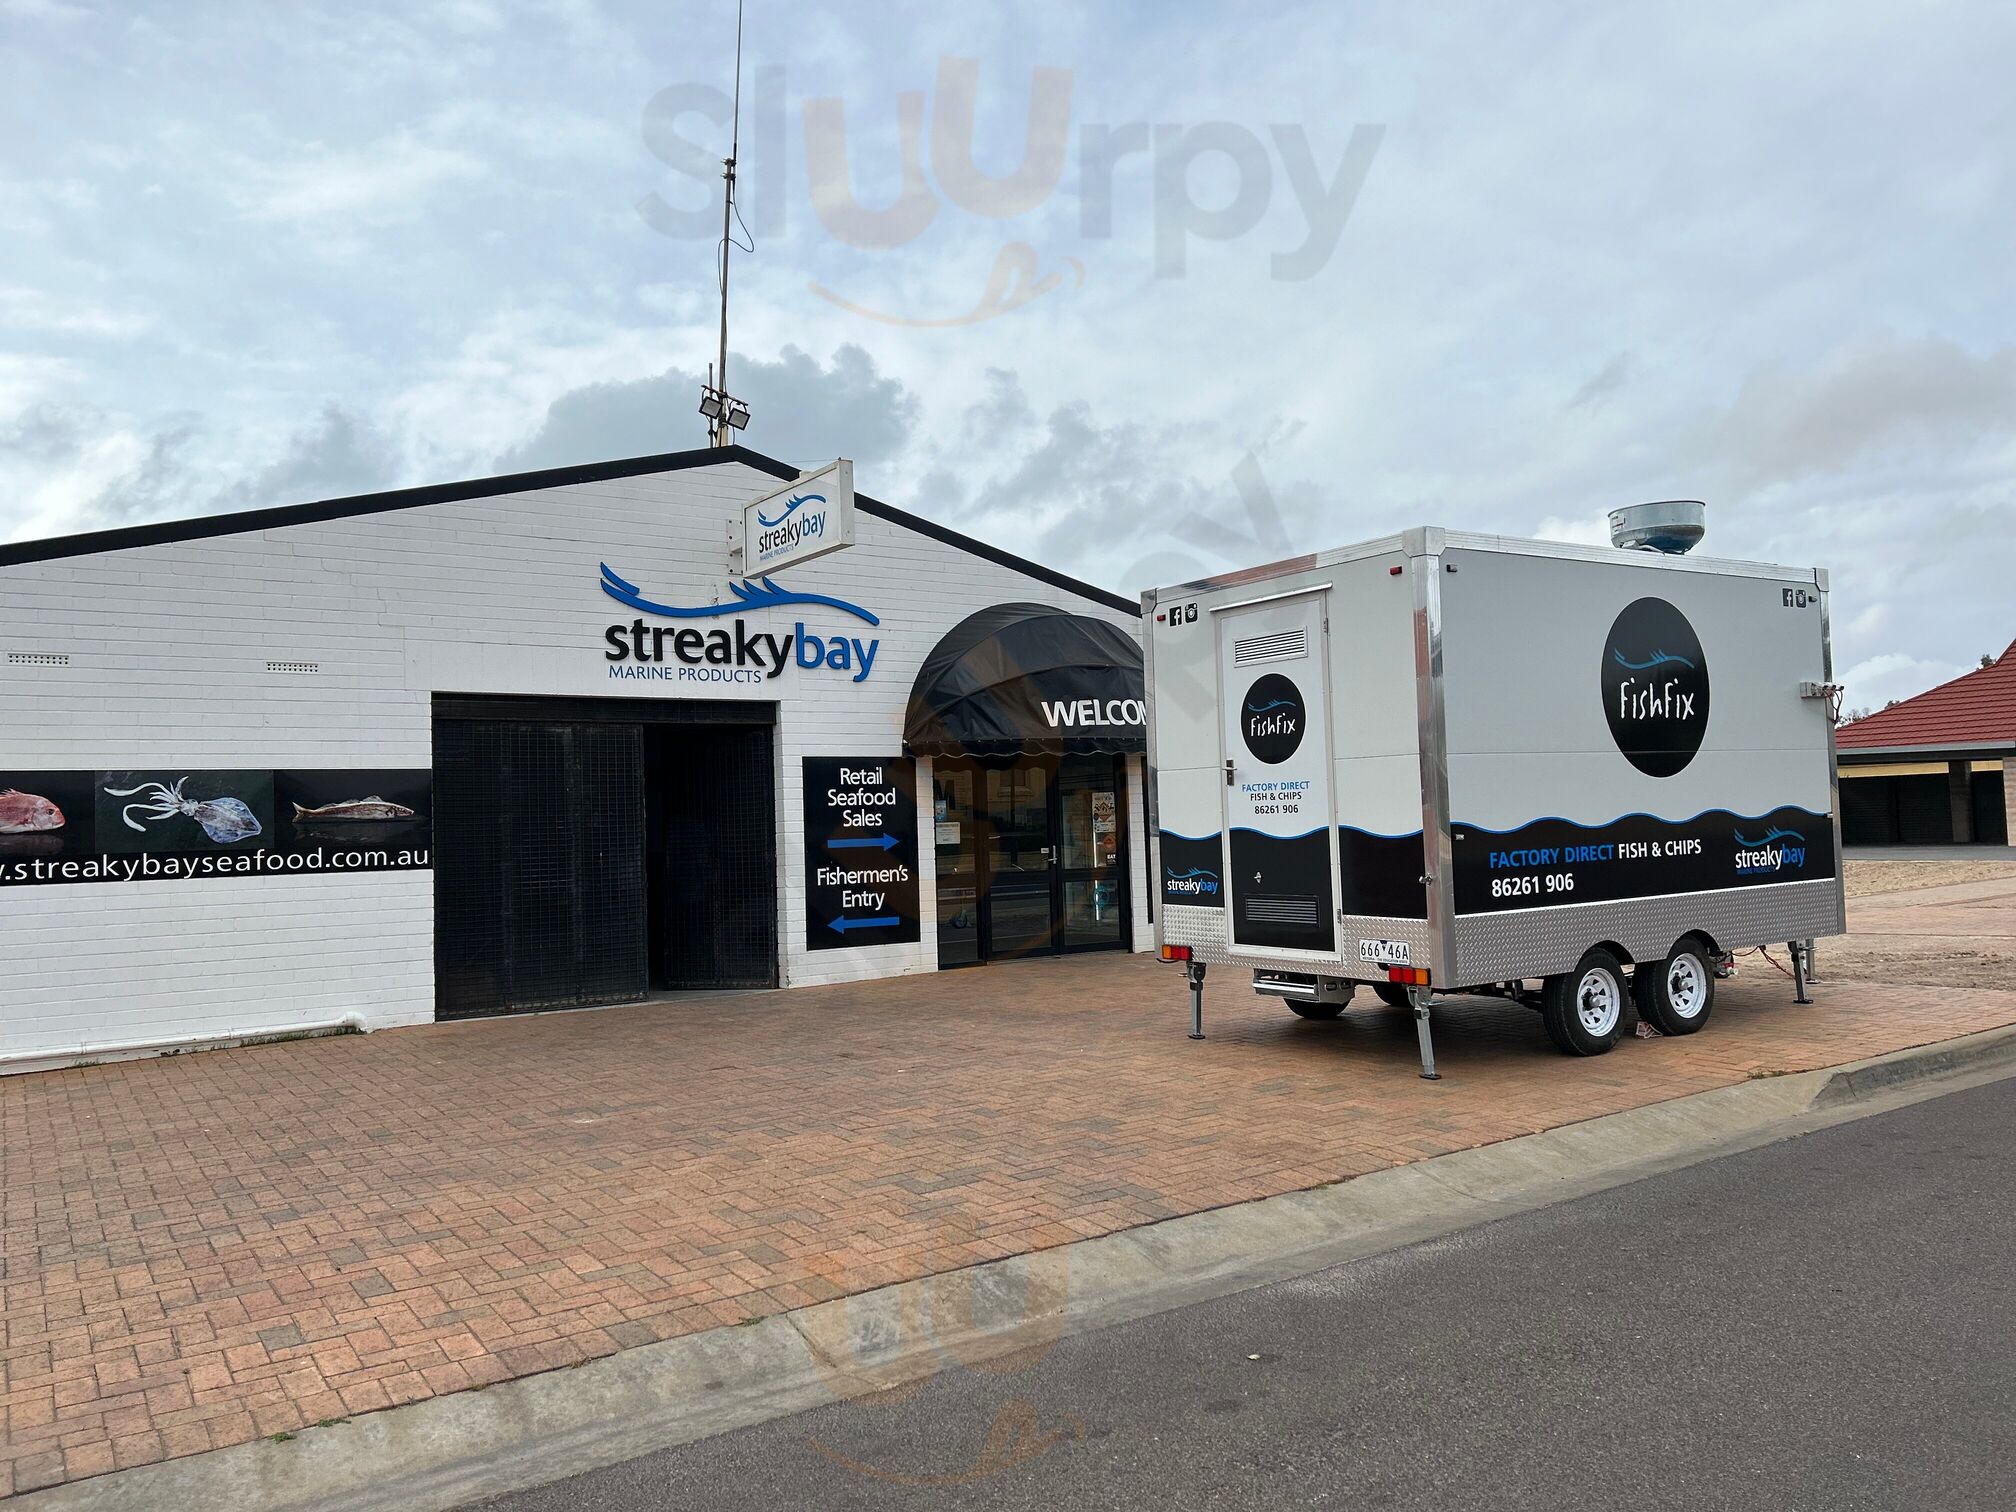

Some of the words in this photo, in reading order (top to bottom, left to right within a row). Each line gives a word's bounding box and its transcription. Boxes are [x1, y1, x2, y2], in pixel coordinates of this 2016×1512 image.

[758, 510, 827, 554] streakybay
[605, 618, 880, 683] streakybay
[608, 665, 673, 681] MARINE
[678, 667, 762, 683] PRODUCTS
[1041, 699, 1146, 727] WELCO
[840, 766, 883, 785] Retail
[1241, 782, 1278, 792] FACTORY
[1280, 781, 1310, 790] DIRECT
[1250, 792, 1268, 802] FISH
[1269, 792, 1276, 801] &
[1278, 791, 1302, 801] CHIPS
[827, 787, 896, 807] Seafood
[843, 808, 882, 827] Sales
[1254, 805, 1280, 815] 86261
[1282, 804, 1299, 814] 906
[1489, 848, 1560, 869] FACTORY
[1564, 844, 1615, 863] DIRECT
[1618, 841, 1648, 860] FISH
[1651, 841, 1662, 857] &
[1665, 838, 1702, 856] CHIPS
[1735, 843, 1805, 870] streakybay
[0, 847, 429, 881] .streakybayseafood.com.au
[817, 864, 909, 886] Fishermen's
[1491, 876, 1540, 897] 86261
[1546, 873, 1574, 892] 906
[1167, 877, 1218, 895] streakybay
[842, 890, 885, 911] Entry
[1360, 942, 1380, 957] 666
[1388, 944, 1409, 960] 46A
